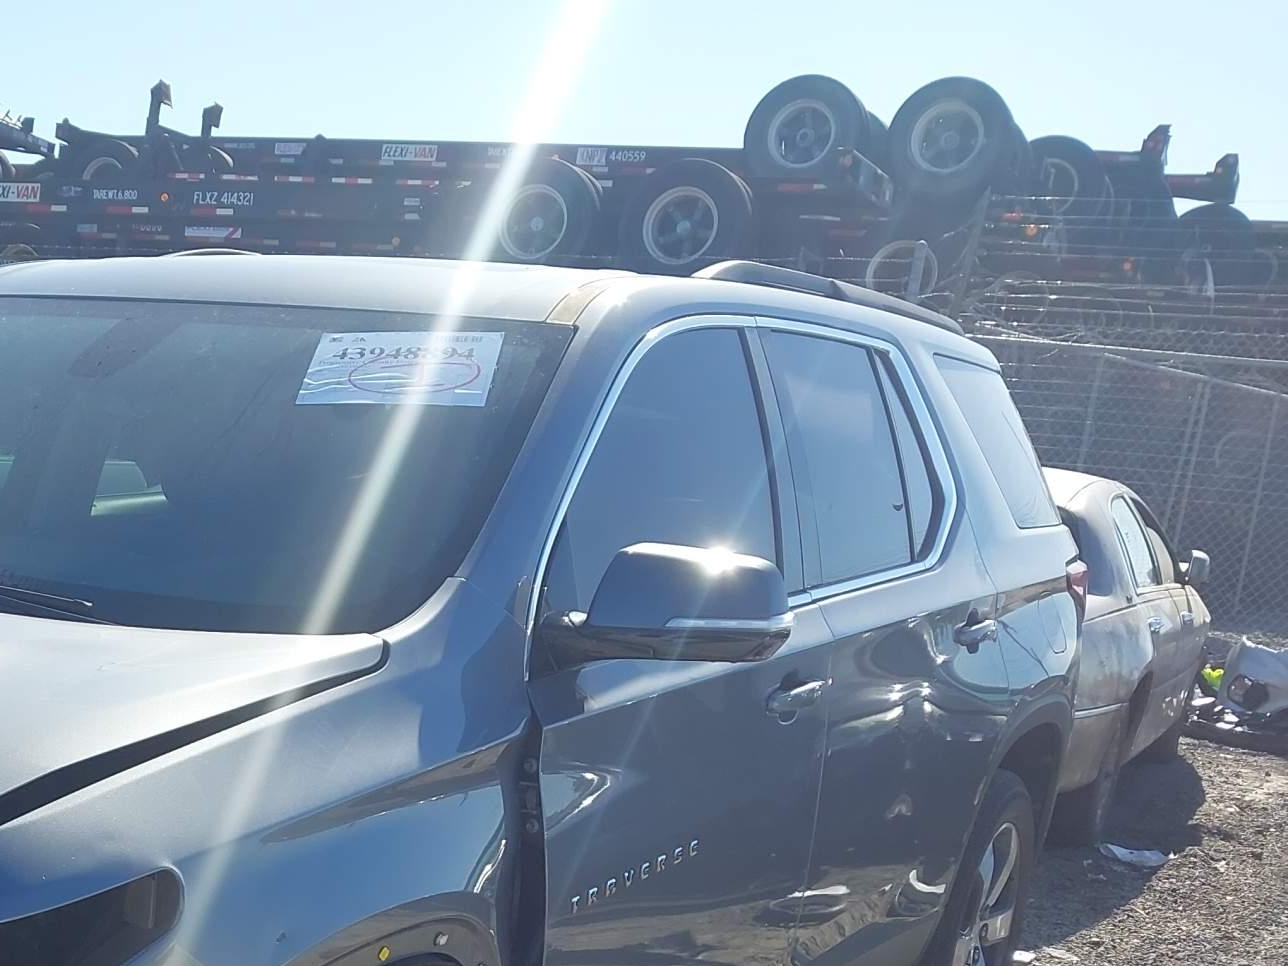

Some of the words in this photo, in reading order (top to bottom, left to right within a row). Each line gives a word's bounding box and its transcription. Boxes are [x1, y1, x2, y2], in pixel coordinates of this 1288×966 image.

[382, 145, 437, 160] FLEXI-VAN
[609, 150, 646, 162] 440559
[193, 191, 217, 204] FLXZ
[220, 191, 253, 205] 414321
[571, 839, 699, 913] TRAVERSE
